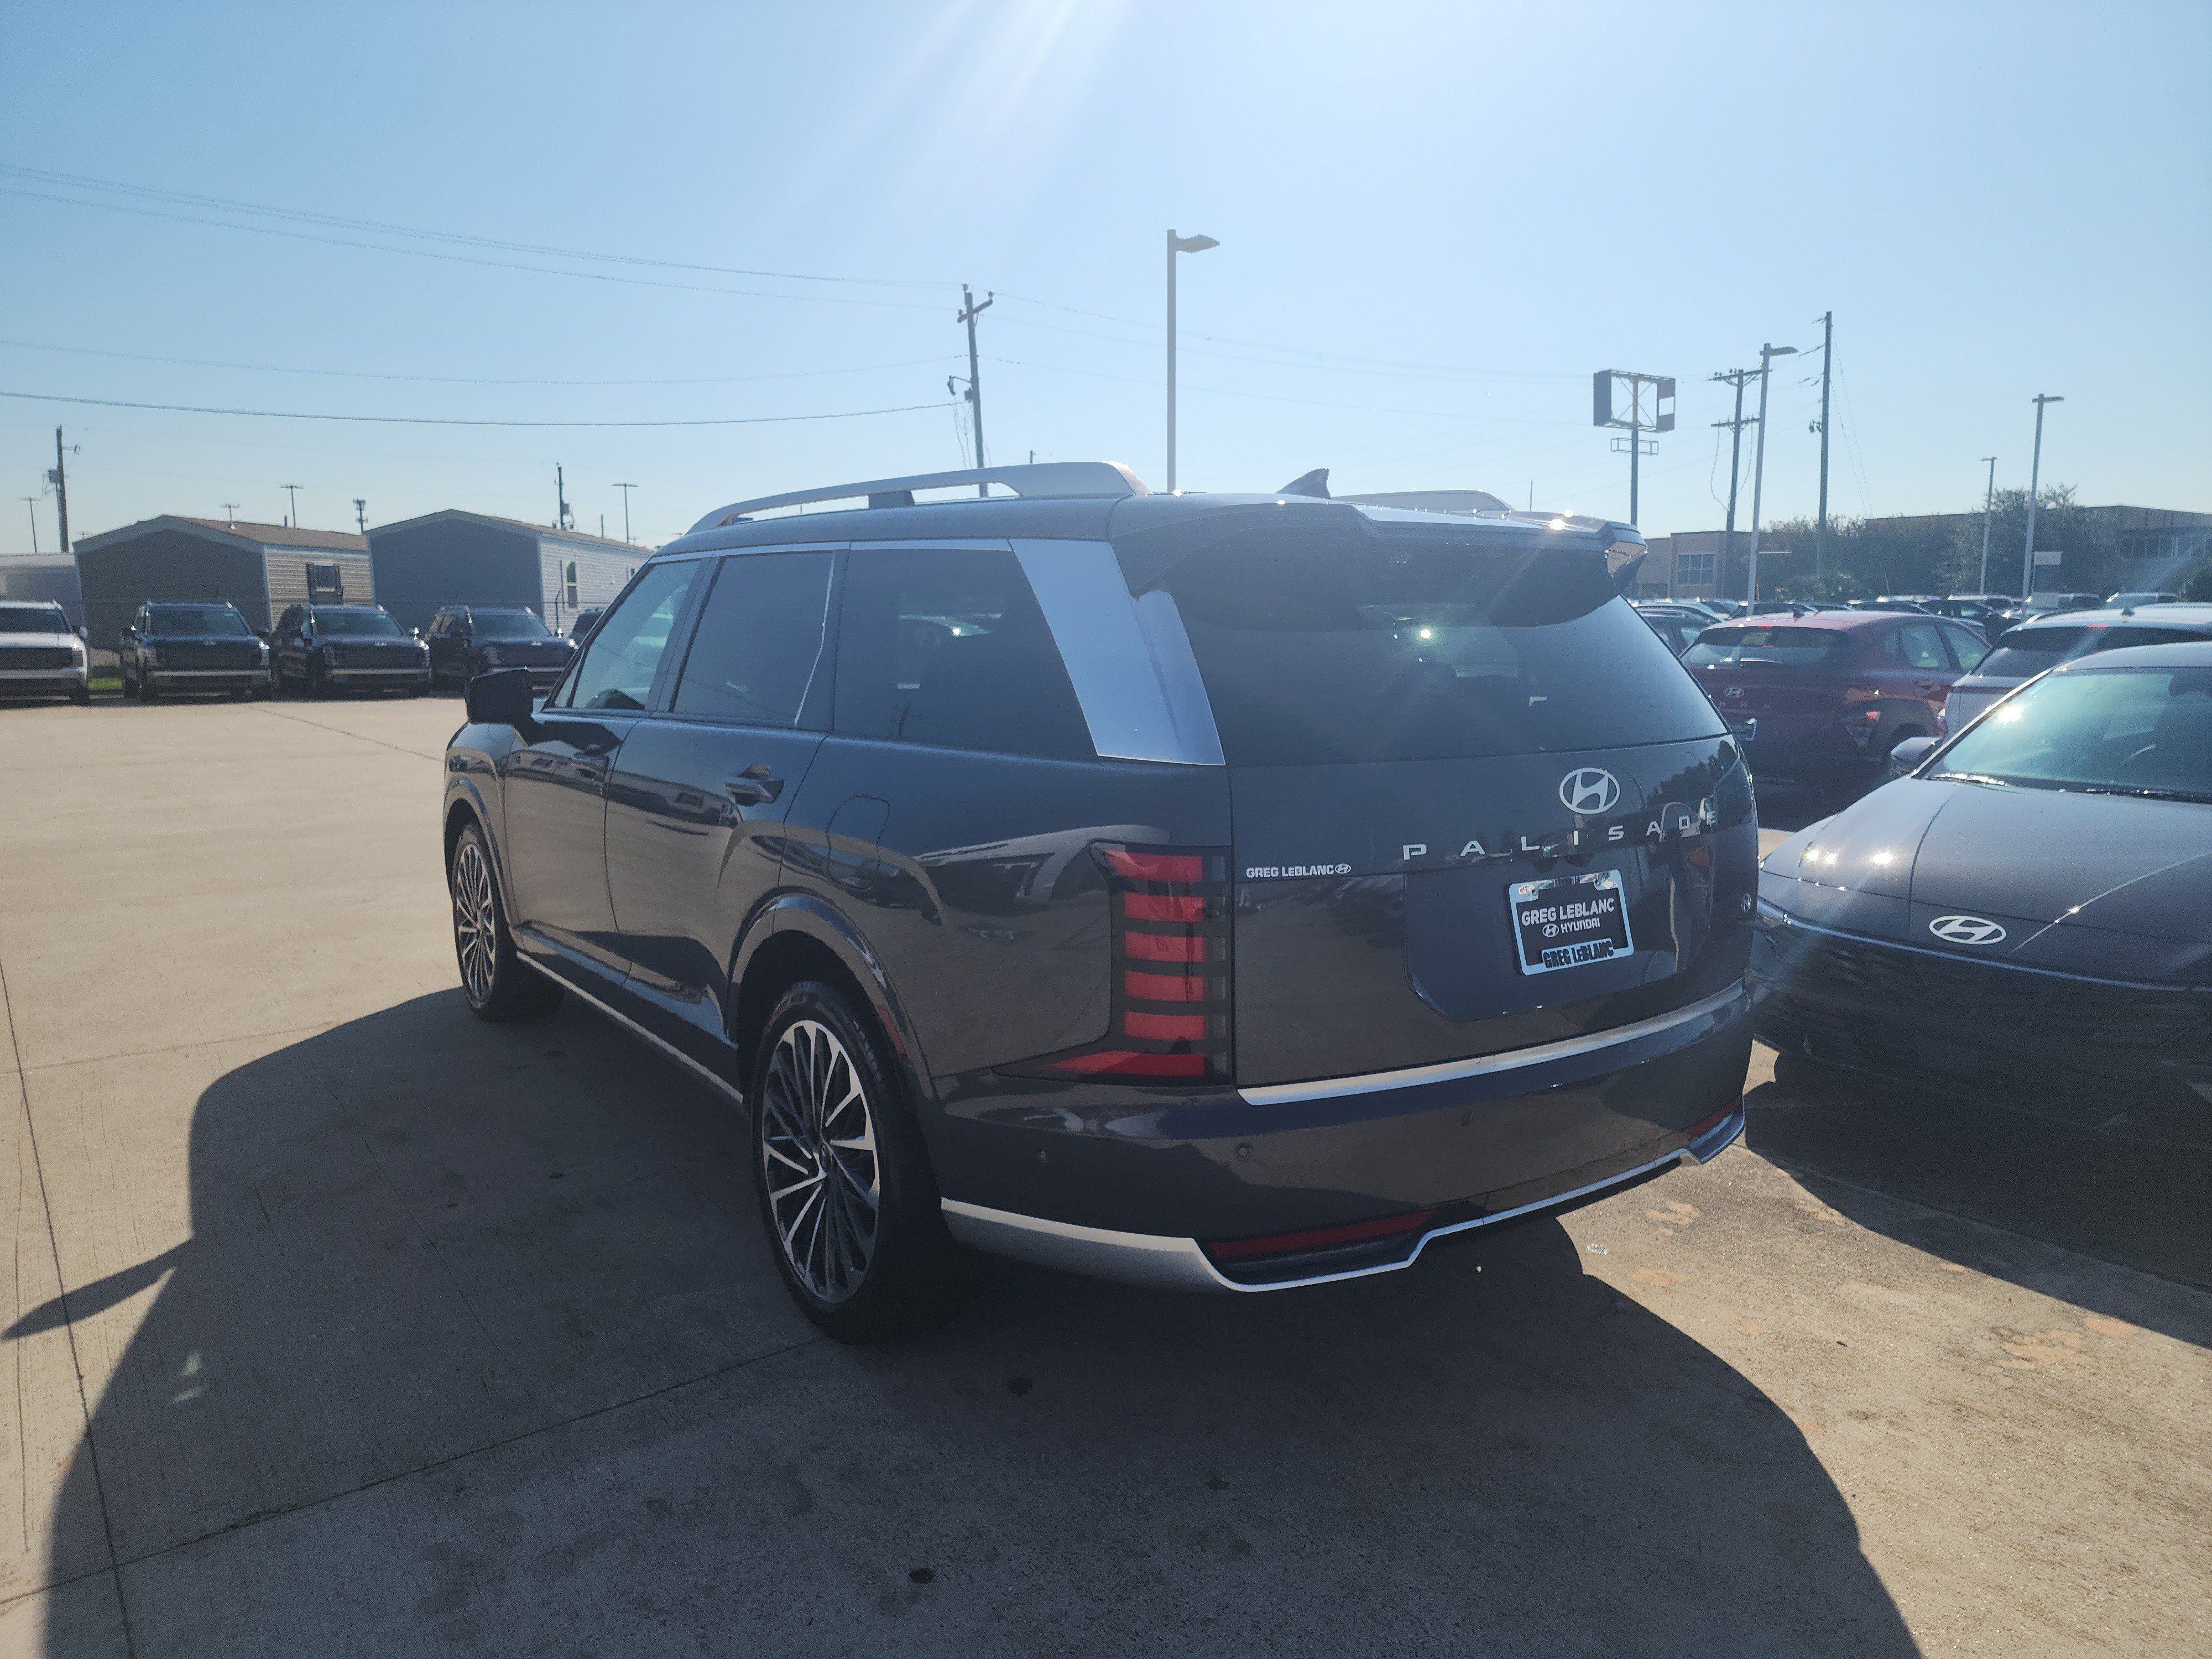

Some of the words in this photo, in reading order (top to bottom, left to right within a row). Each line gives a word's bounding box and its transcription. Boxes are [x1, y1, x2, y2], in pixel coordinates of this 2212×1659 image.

[1402, 811, 1716, 860] PALISADE
[1246, 867, 1279, 878] GREG
[1521, 907, 1557, 926] GREG
[1559, 898, 1615, 920] LEBLANC
[1560, 917, 1600, 934] HYUNDAI
[1543, 948, 1572, 968] GREG
